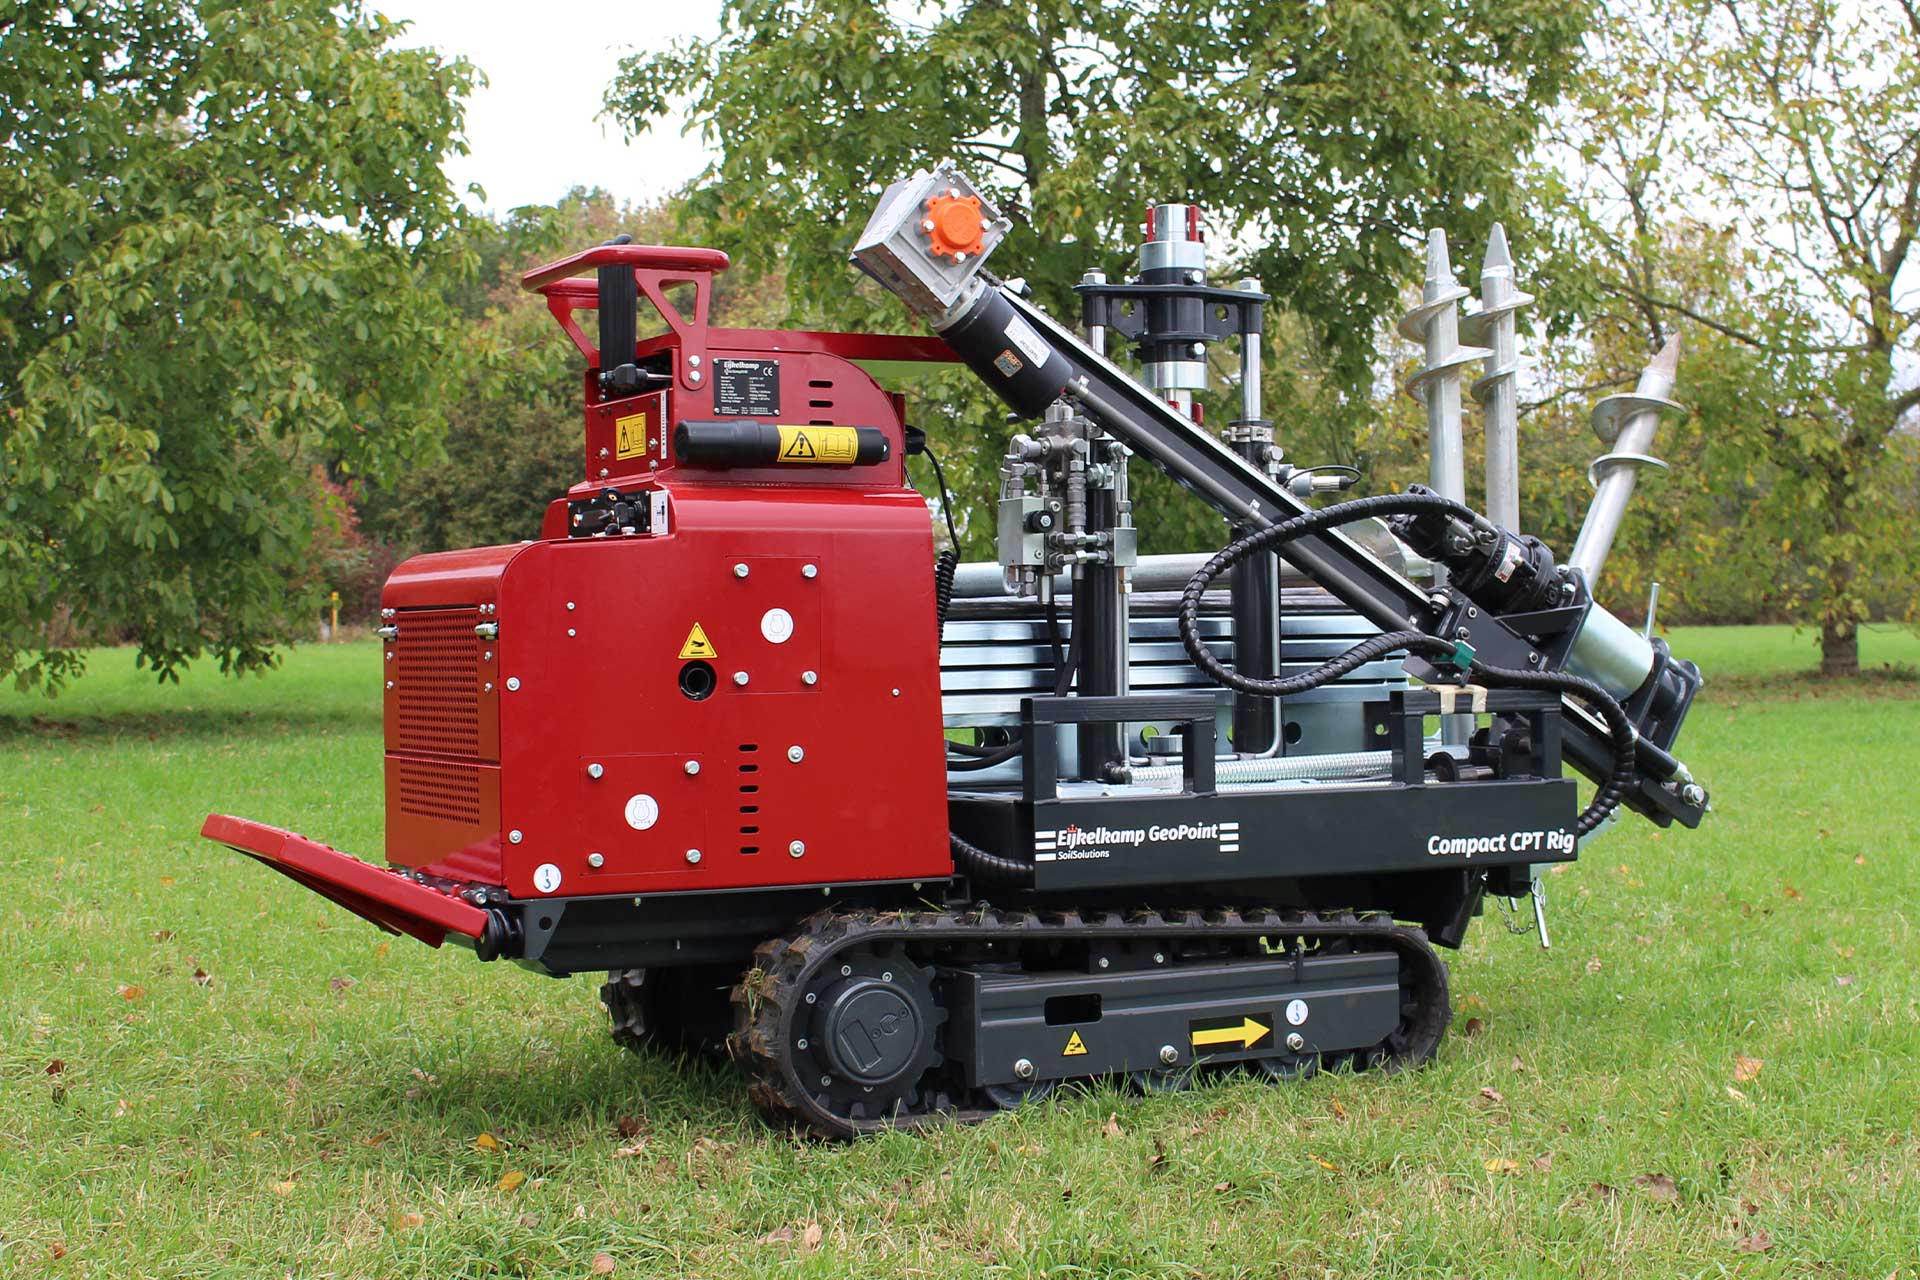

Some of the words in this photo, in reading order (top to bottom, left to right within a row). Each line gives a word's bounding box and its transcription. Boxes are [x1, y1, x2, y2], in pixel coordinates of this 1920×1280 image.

[1057, 826, 1145, 850] Eijkelkamp
[1148, 821, 1218, 842] GeoPoint
[1427, 833, 1506, 859] Compact
[1509, 831, 1544, 851] CPT
[1546, 827, 1575, 854] Rig
[1057, 848, 1110, 861] SoilSolutions
